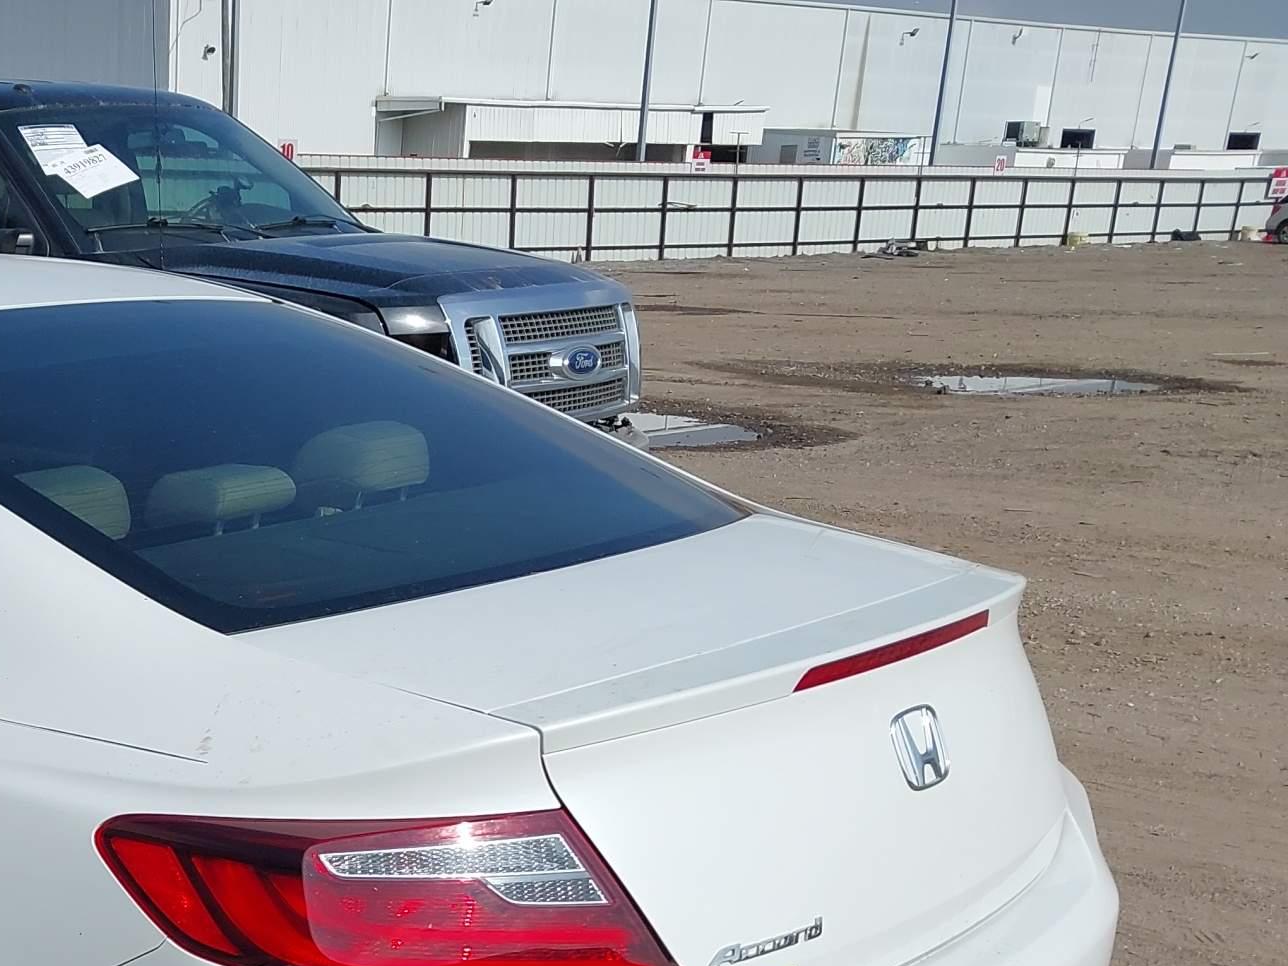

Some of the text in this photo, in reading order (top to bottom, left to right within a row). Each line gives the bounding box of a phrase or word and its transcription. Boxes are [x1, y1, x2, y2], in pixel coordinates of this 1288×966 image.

[280, 143, 294, 161] 10
[995, 158, 1006, 172] 20
[575, 352, 594, 370] Ford
